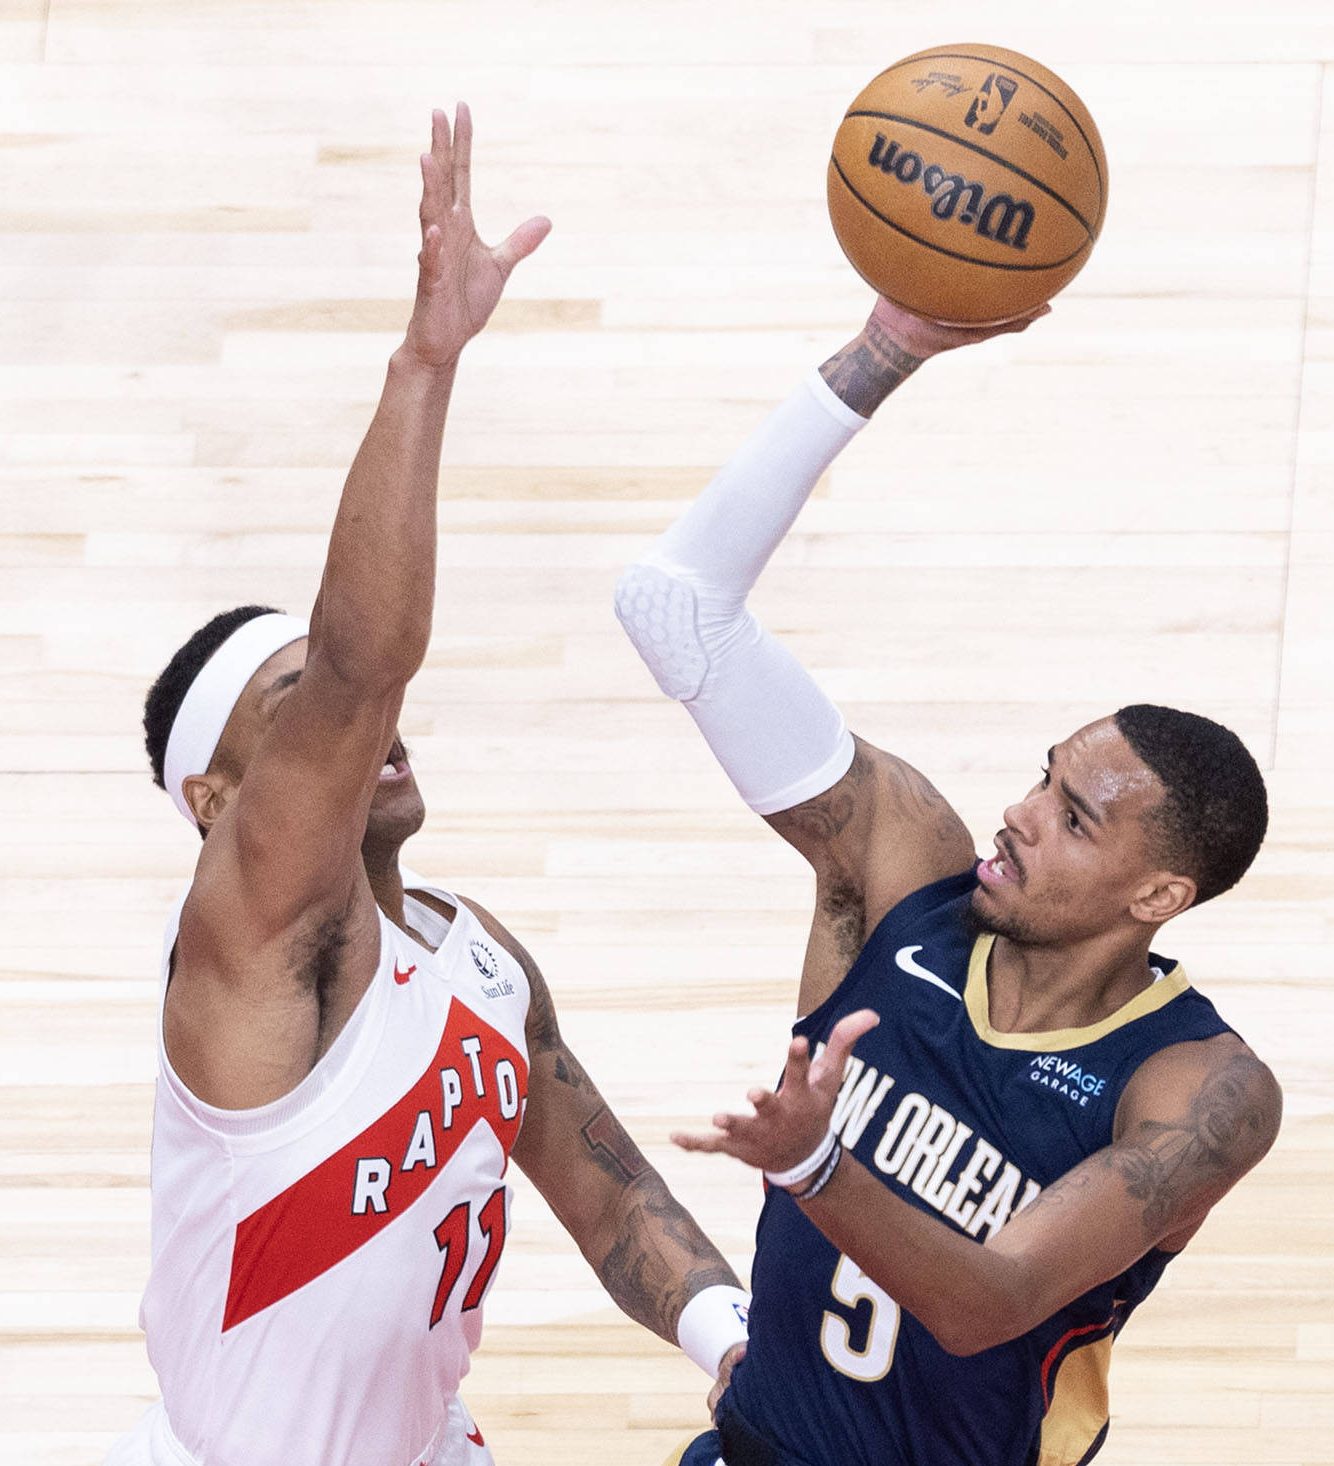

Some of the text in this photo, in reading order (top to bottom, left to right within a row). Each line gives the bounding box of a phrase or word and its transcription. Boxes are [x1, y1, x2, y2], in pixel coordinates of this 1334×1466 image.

[868, 132, 1036, 251] Wilson
[350, 1035, 529, 1215] RAPTO
[1030, 1070, 1089, 1107] GARAGE
[429, 1185, 506, 1332] 11
[820, 1252, 901, 1382] 5
